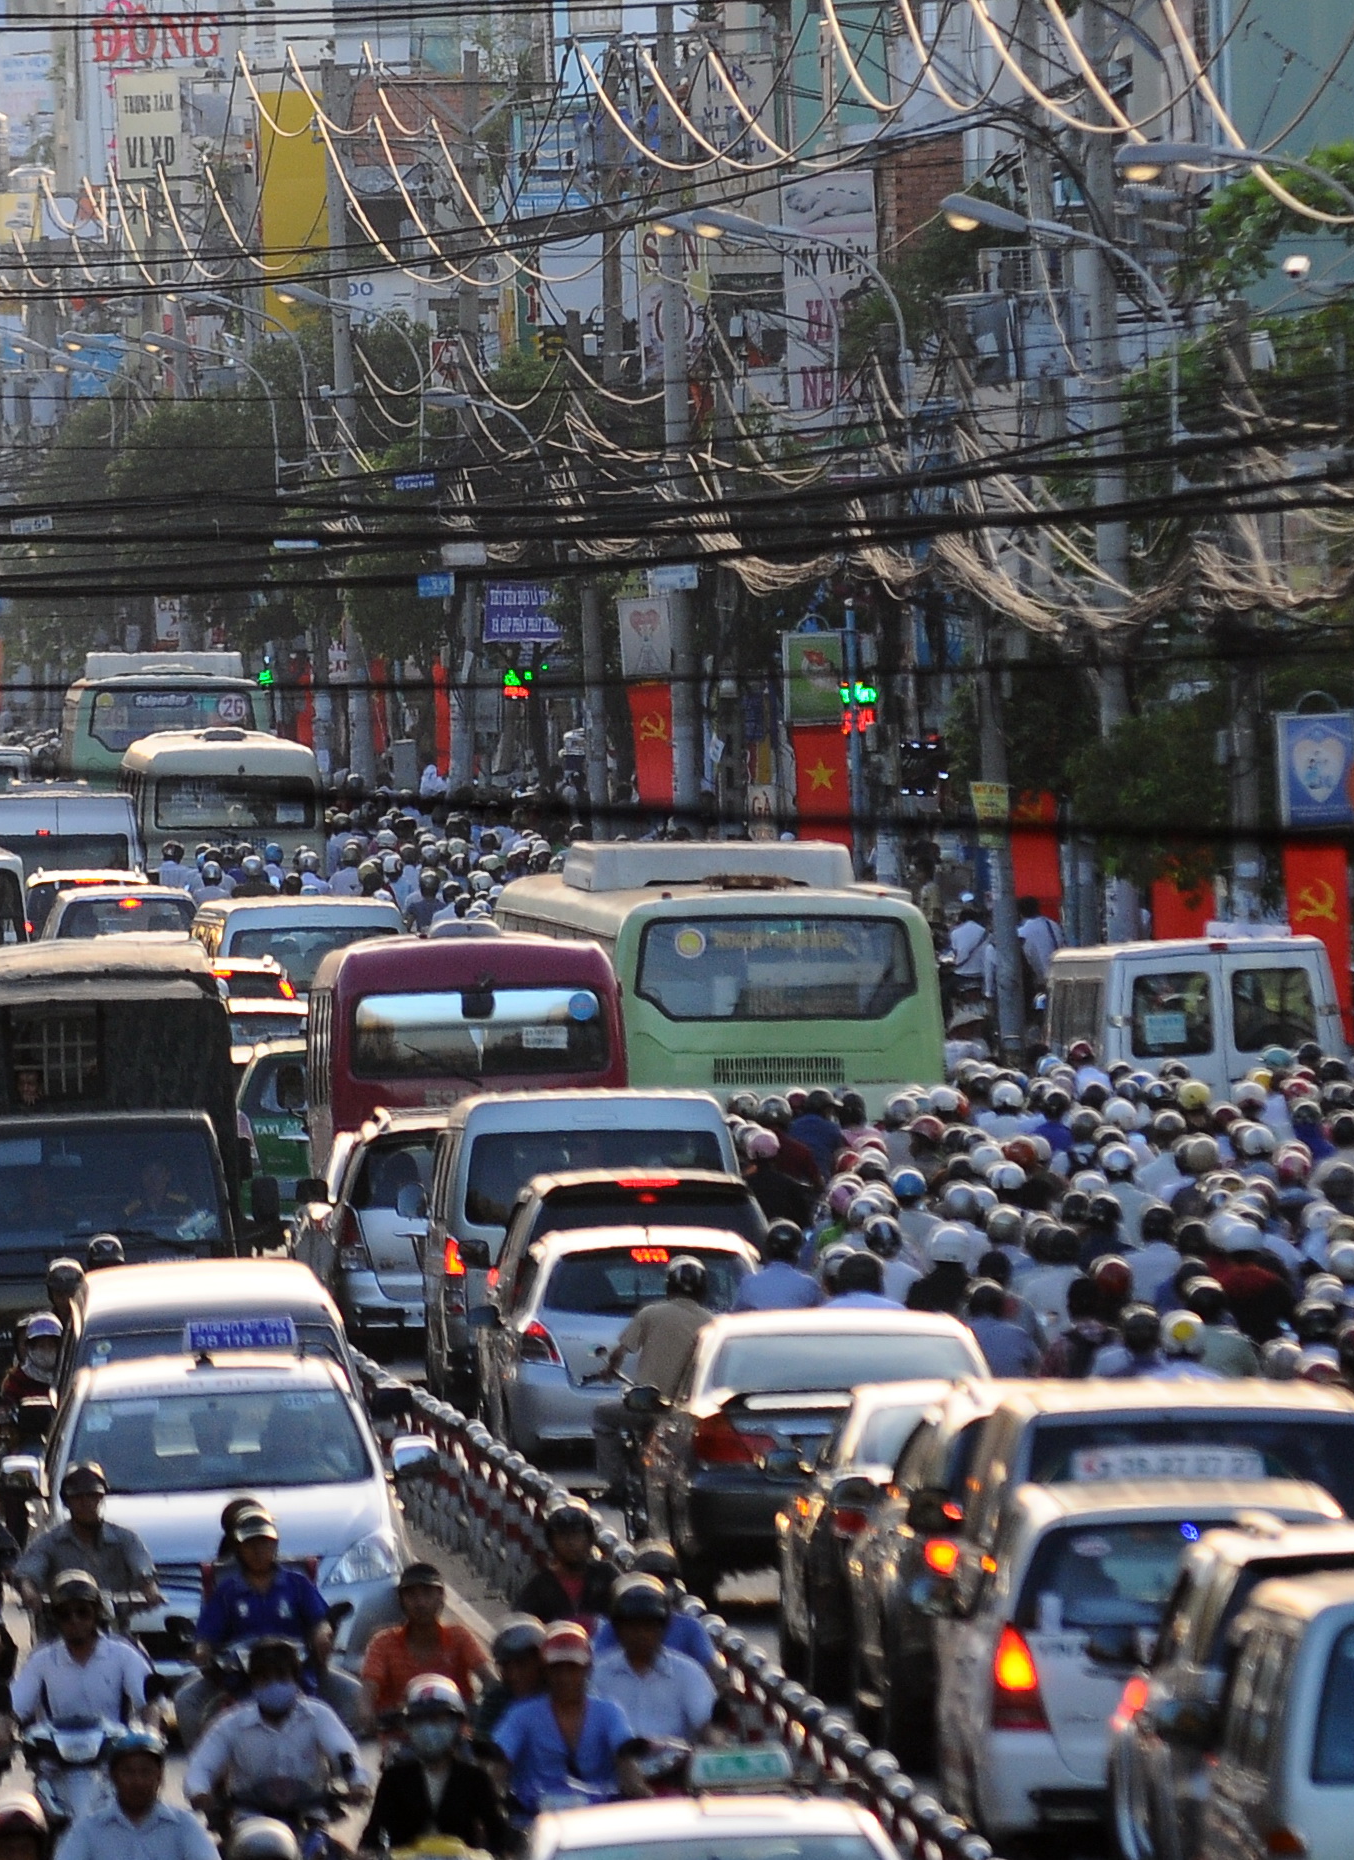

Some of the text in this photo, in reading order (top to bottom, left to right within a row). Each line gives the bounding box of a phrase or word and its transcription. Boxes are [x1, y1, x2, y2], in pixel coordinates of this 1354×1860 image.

[91, 3, 221, 63] ĐÔNG
[125, 136, 176, 168] VLXD
[643, 232, 699, 274] SN
[222, 698, 245, 718] 26
[254, 1124, 280, 1135] TAXI
[224, 1333, 254, 1347] 118
[259, 1332, 288, 1346] 118
